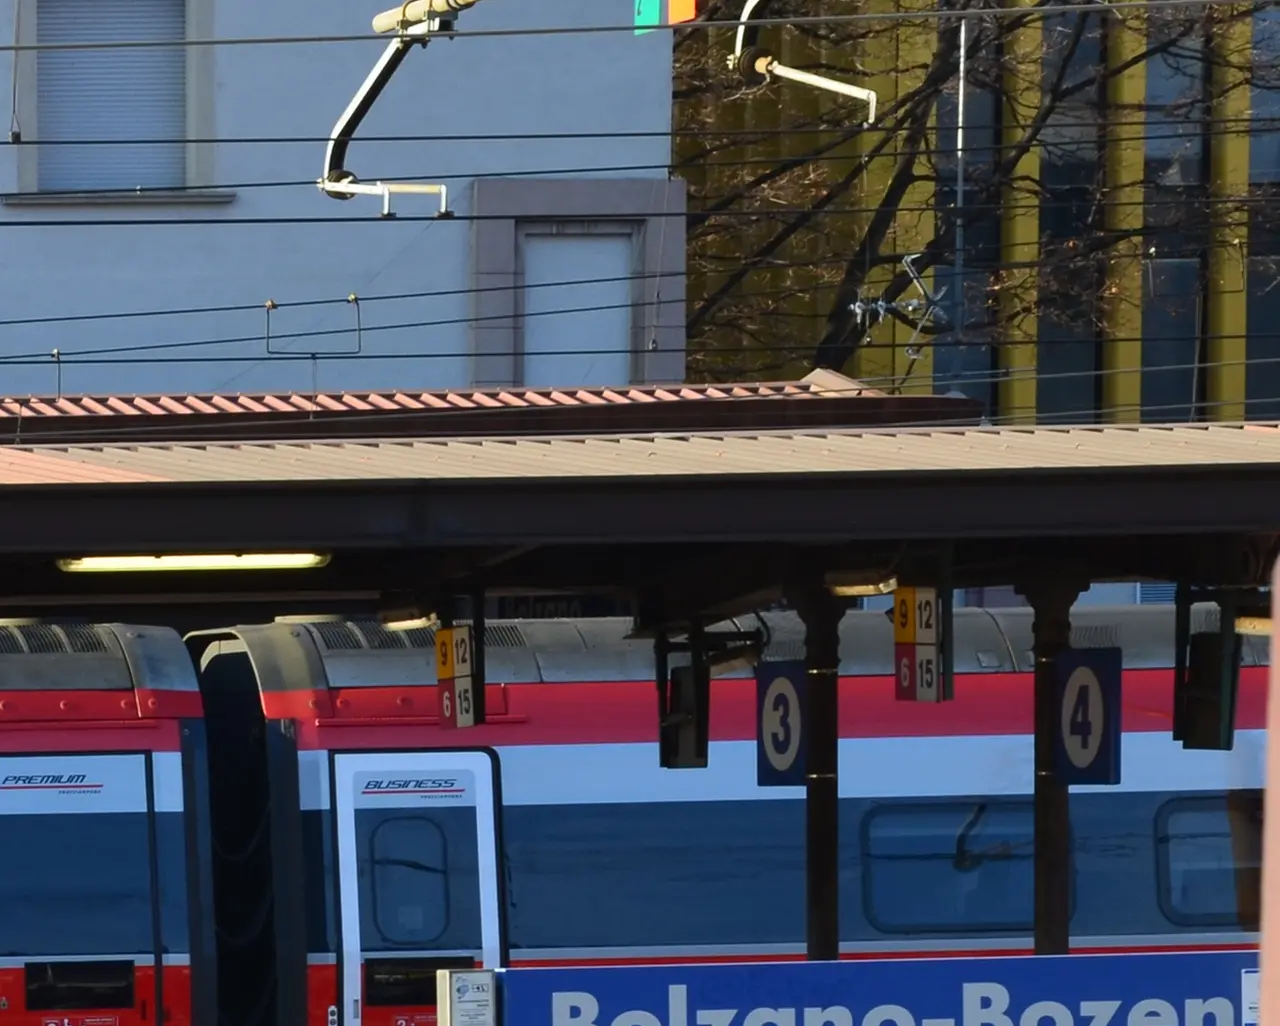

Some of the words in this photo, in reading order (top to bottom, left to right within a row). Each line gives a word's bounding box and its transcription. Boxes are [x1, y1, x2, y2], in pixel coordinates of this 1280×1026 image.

[900, 599, 908, 629] 9
[918, 600, 933, 629] 12
[441, 640, 448, 667] 9
[455, 638, 468, 664] 12
[901, 658, 910, 687] 6
[919, 659, 934, 688] 15
[443, 691, 451, 717] 6
[458, 688, 471, 715] 15
[1070, 684, 1093, 750] 4
[771, 692, 791, 755] 3
[2, 774, 87, 785] PREMIUM
[364, 778, 458, 790] BUSINESS
